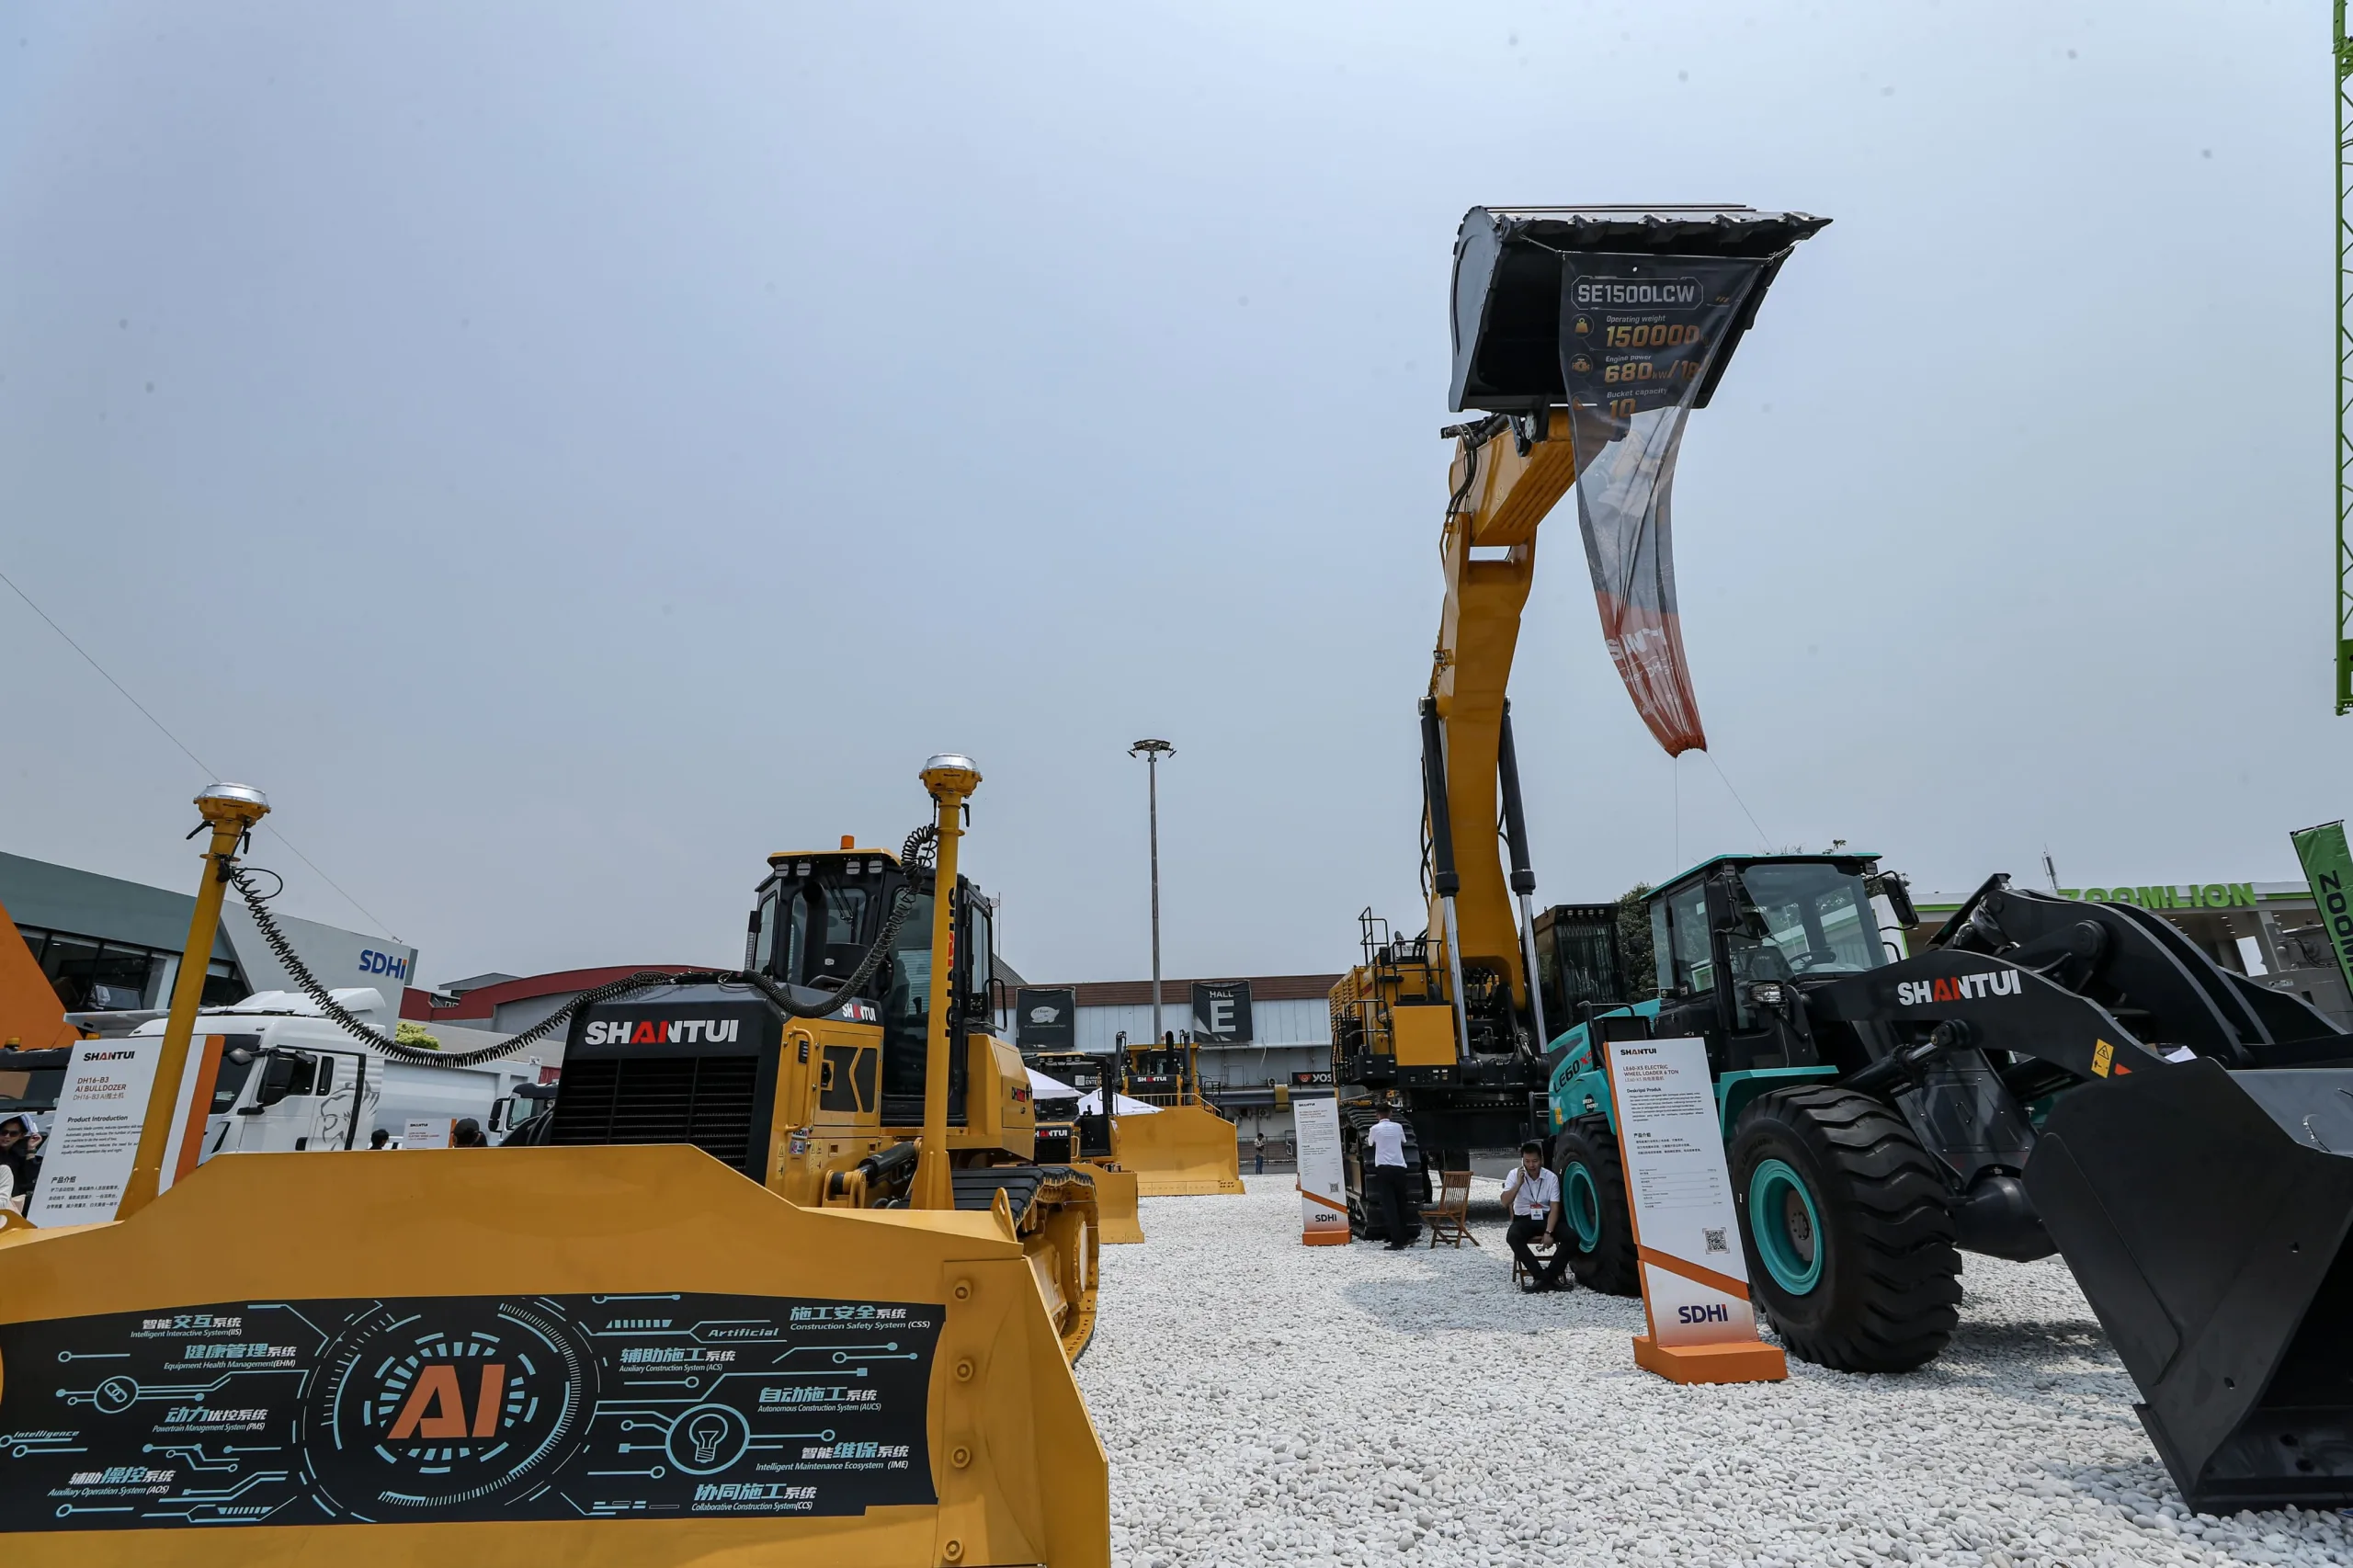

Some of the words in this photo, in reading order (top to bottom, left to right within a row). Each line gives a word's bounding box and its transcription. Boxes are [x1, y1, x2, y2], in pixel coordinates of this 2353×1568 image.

[1577, 284, 1695, 304] SE1500LCW
[1606, 315, 1641, 324] Operating
[1641, 314, 1665, 324] weight
[1605, 356, 1629, 364] Engine
[1607, 390, 1632, 399] Bucket
[1635, 387, 1668, 396] capacity
[1897, 970, 2022, 1006] SHANTUI
[842, 1004, 876, 1021] SHANTUI
[1210, 1000, 1236, 1032] E
[585, 1019, 739, 1045] SHANTUI
[84, 1051, 135, 1062] SHANTUI
[77, 1076, 109, 1085] DH16-B3
[1034, 1130, 1068, 1138] HANTUI
[51, 1176, 77, 1184] 产品介绍
[1314, 1214, 1337, 1222] SDHI
[790, 1305, 907, 1321] 施工安全系统
[1677, 1303, 1728, 1324] SDHI
[142, 1313, 243, 1330] 智能交互系统
[790, 1322, 845, 1331] Construction
[846, 1322, 873, 1331] Safety
[874, 1322, 906, 1330] System
[907, 1321, 930, 1329] (CSS)
[131, 1330, 165, 1338] Intelligent
[166, 1329, 201, 1337] Interactive
[202, 1329, 242, 1337] System(IIS)
[708, 1328, 779, 1337] Artificial
[184, 1343, 297, 1359] 健康管理系统
[620, 1347, 736, 1363] 辅助施工系统
[164, 1362, 201, 1370] Equipment
[226, 1359, 296, 1369] Management(EHM)
[619, 1365, 645, 1373] Auxiliary
[645, 1364, 683, 1372] Construction
[684, 1364, 706, 1372] System
[706, 1363, 723, 1372] (ACS)
[758, 1386, 878, 1403] 自动施工系统
[386, 1364, 506, 1439] AI
[165, 1405, 269, 1423] 动力优控系统
[757, 1404, 797, 1413] Autonomous
[798, 1403, 836, 1412] Construction
[836, 1403, 859, 1413] System
[859, 1403, 881, 1412] (AUCS)
[152, 1424, 184, 1433] Powertrain
[185, 1424, 223, 1433] Management
[224, 1423, 245, 1432] System
[246, 1422, 266, 1432] (PMS)
[14, 1430, 80, 1438] Intelligence
[801, 1441, 910, 1460] 智能维保系统
[756, 1462, 794, 1472] Intelligent
[795, 1461, 844, 1471] Maintenance
[844, 1461, 883, 1471] Ecosystem
[887, 1460, 908, 1470] (IME)
[68, 1466, 176, 1485] 辅助操控系统
[47, 1487, 81, 1497] Auxiliary
[81, 1487, 119, 1497] Operation
[119, 1486, 146, 1495] System
[146, 1485, 170, 1495] (AOS)
[693, 1483, 817, 1501] 协同施工系统
[691, 1503, 733, 1511] Collaborative
[733, 1502, 772, 1510] Construction
[772, 1501, 813, 1512] System(CCS)
